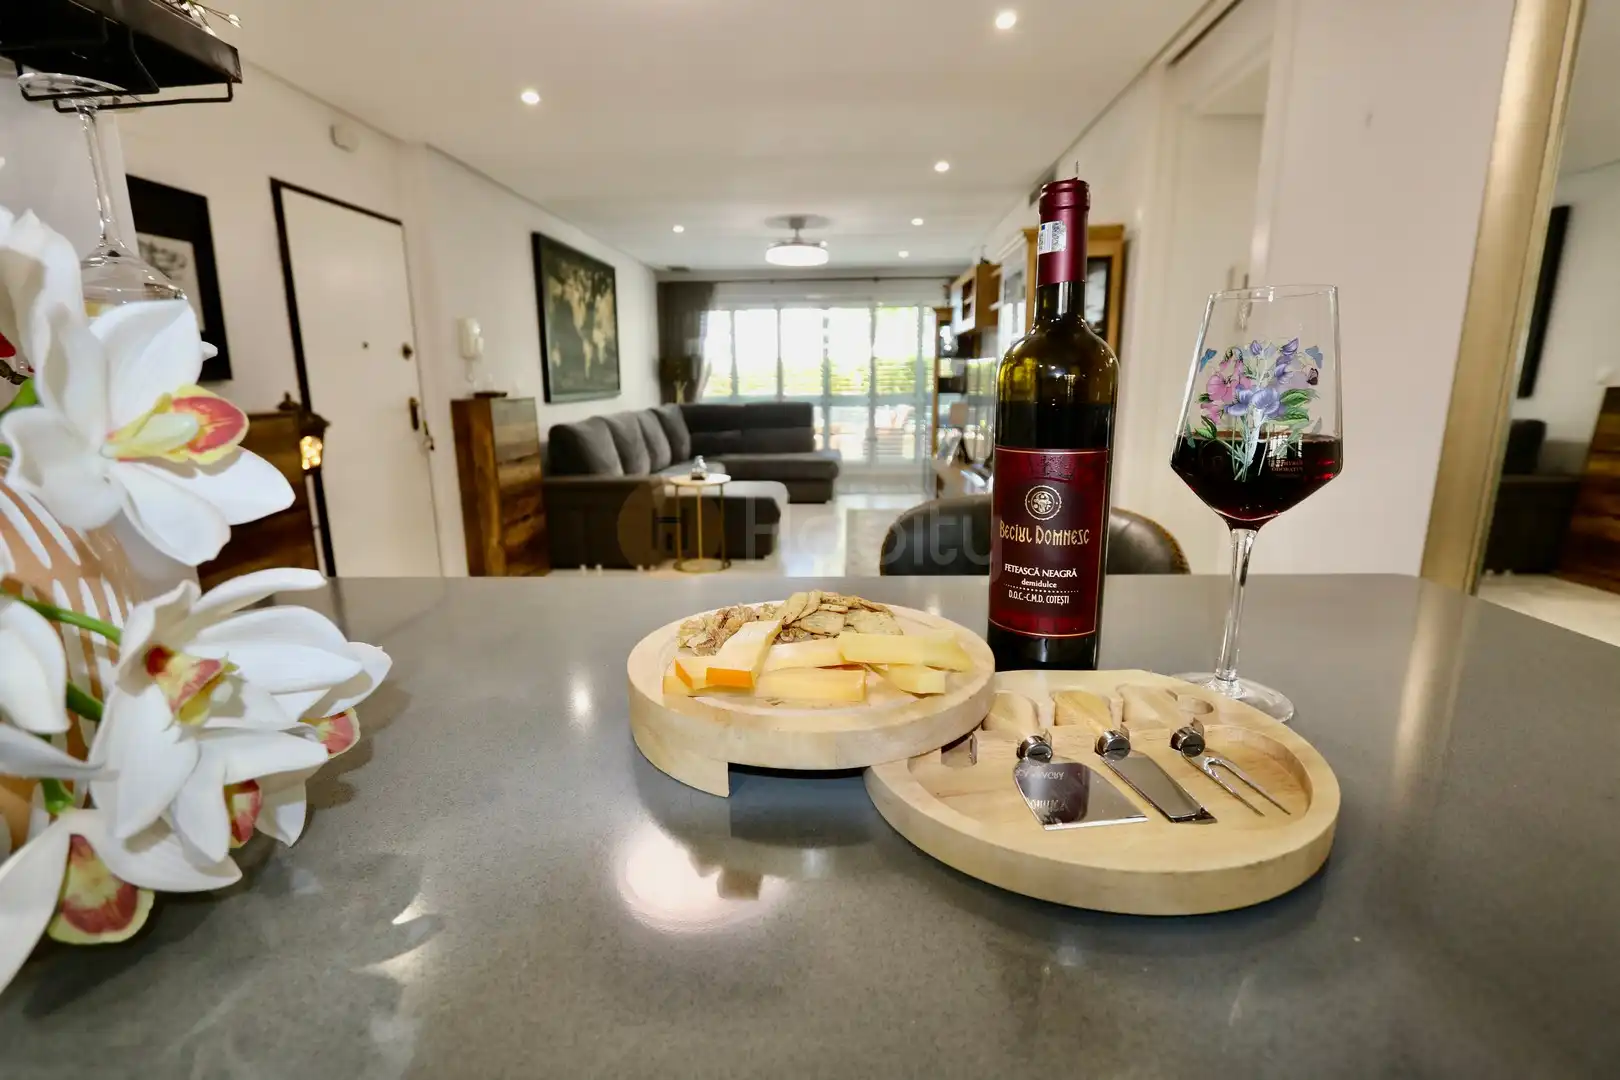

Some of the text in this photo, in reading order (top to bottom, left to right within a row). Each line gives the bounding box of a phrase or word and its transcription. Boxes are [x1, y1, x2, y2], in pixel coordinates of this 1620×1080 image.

[1004, 563, 1078, 578] FETEASCĂ NEAGRĂ
[1021, 578, 1058, 589] demidulce
